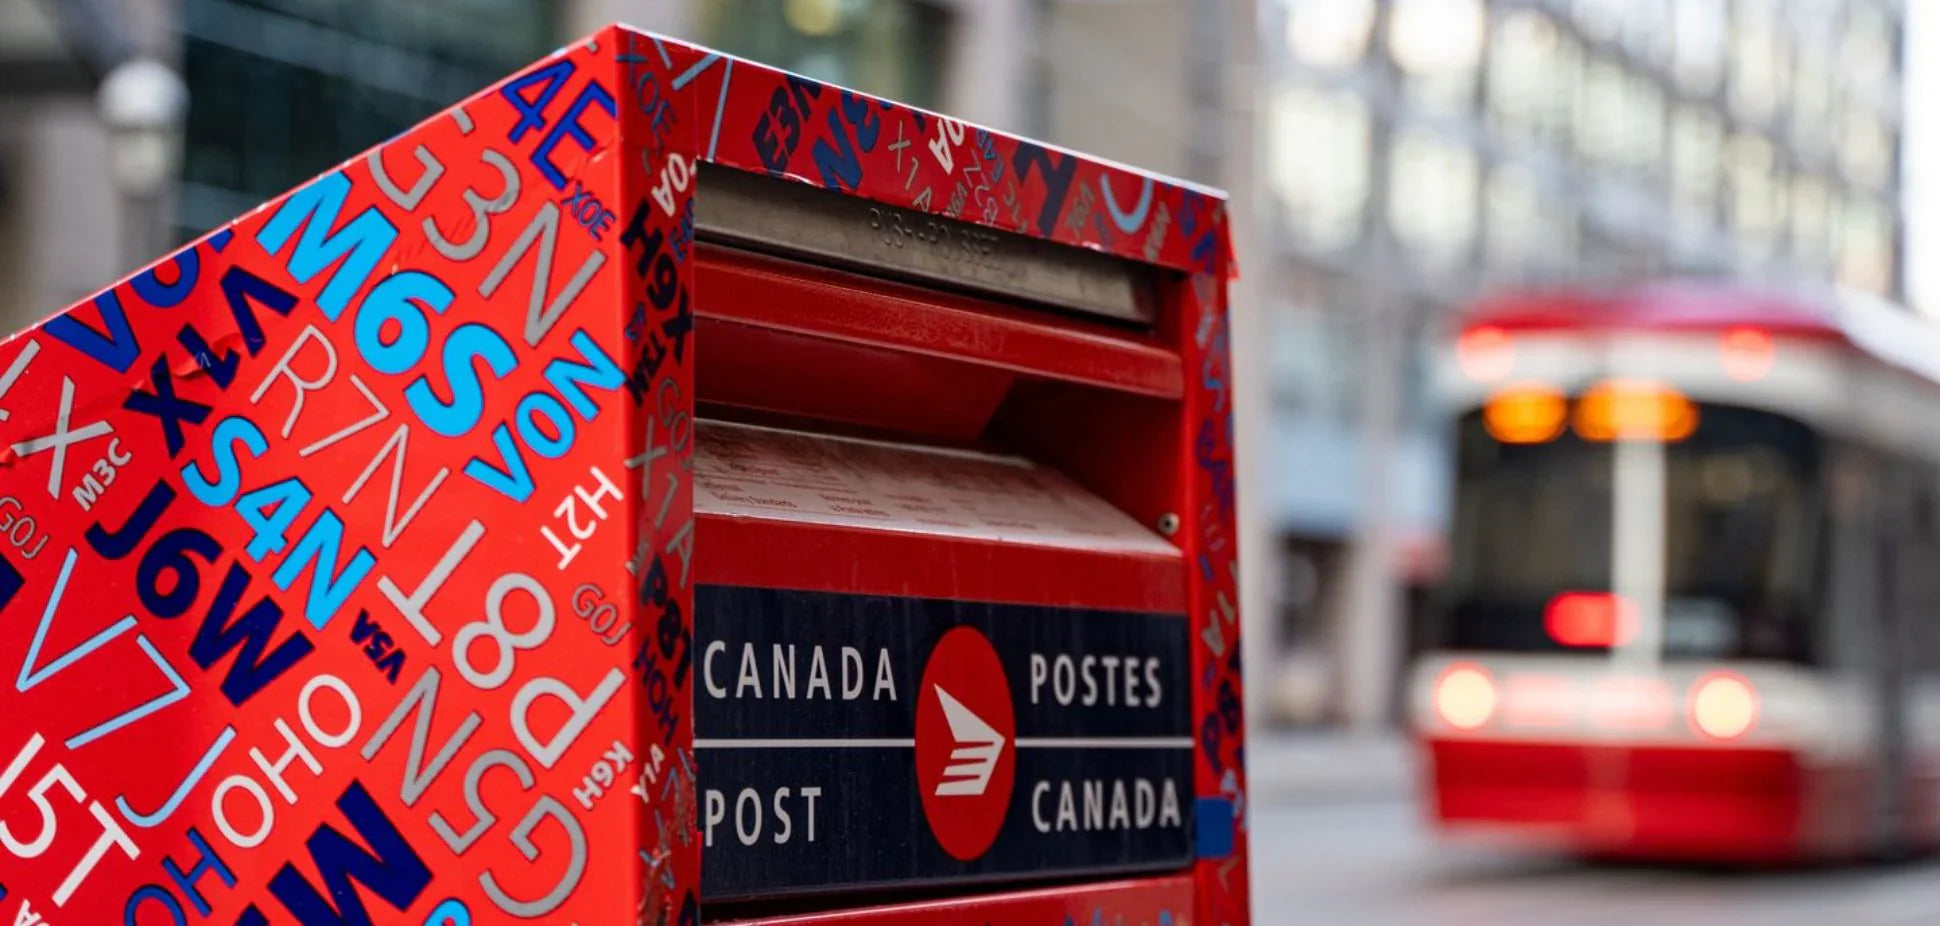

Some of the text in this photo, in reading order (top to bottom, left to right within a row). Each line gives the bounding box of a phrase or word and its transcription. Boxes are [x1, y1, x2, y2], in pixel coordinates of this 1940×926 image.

[254, 168, 520, 438] M6S
[367, 106, 607, 348] G3N
[619, 200, 694, 365] H9X
[70, 436, 132, 513] M3C
[179, 414, 379, 634] S4N
[249, 323, 451, 548] R7N
[539, 465, 624, 571] H2T
[15, 547, 237, 829] V7J
[83, 477, 316, 709] J6W
[376, 519, 627, 770] P8T
[703, 640, 898, 701] CANADA
[1030, 653, 1163, 709] POSTES
[359, 664, 588, 919] G5N
[572, 740, 635, 811] K6H
[704, 786, 823, 848] POST
[1031, 778, 1182, 834] CANADA
